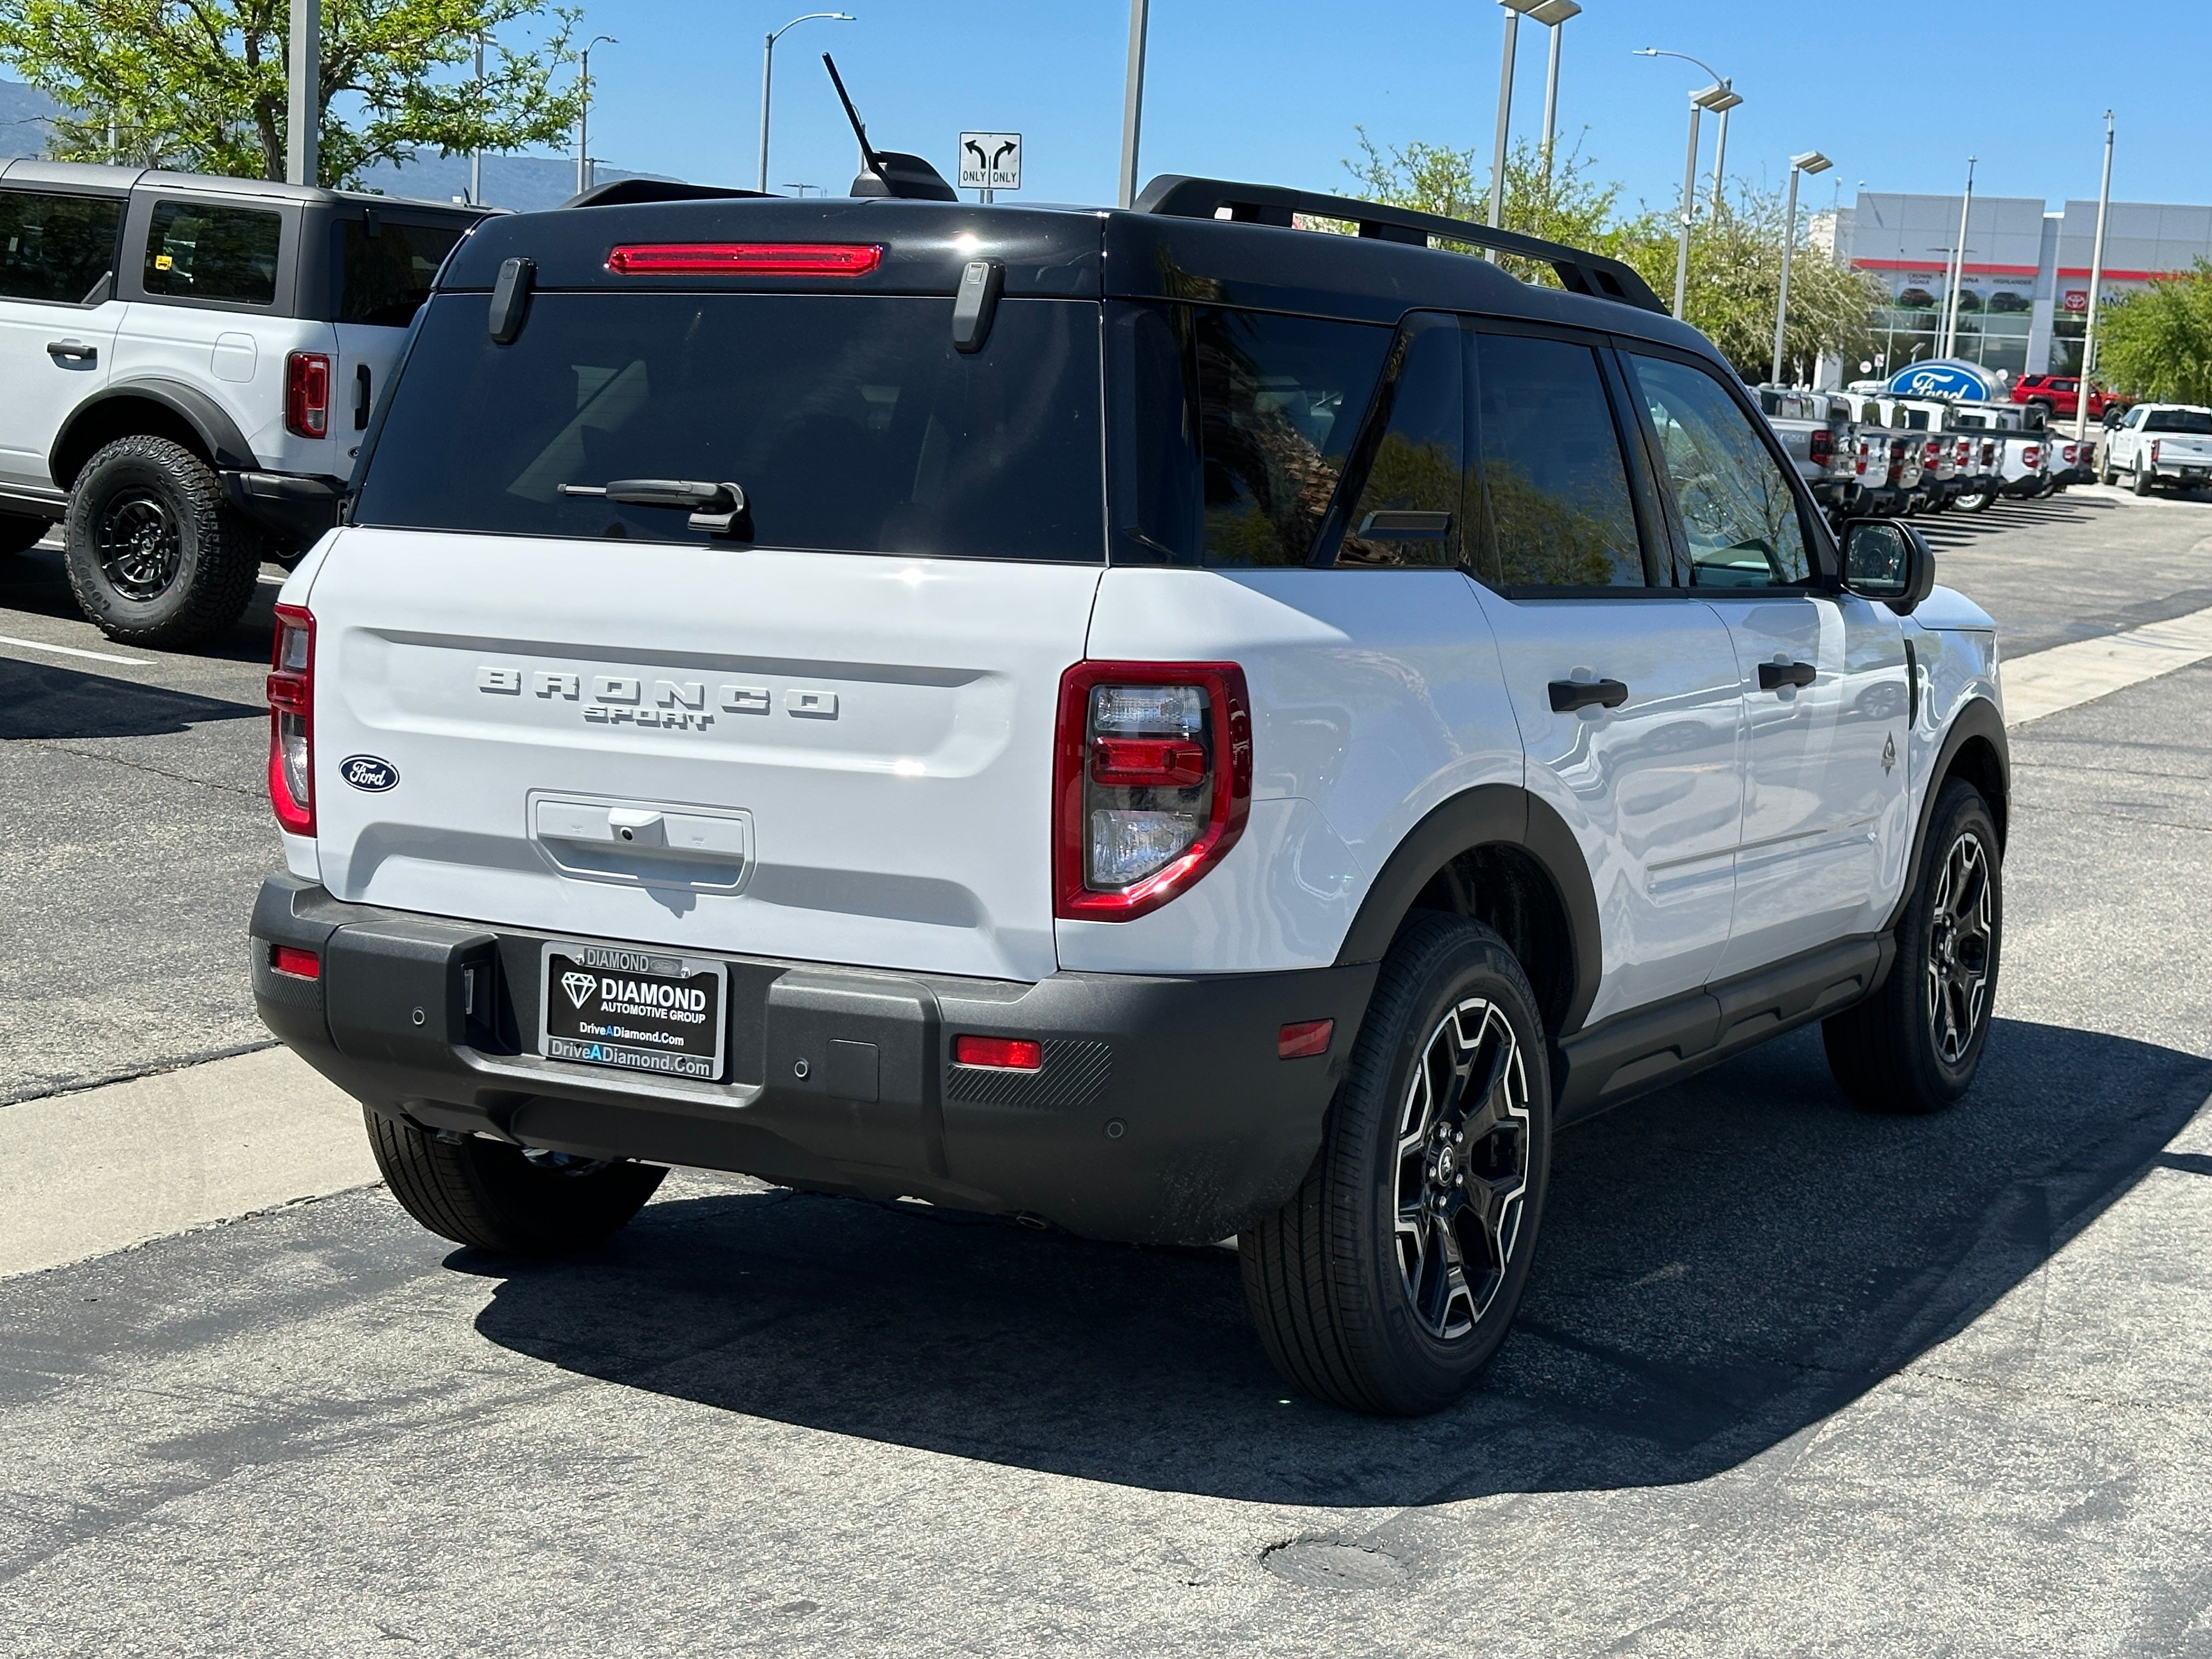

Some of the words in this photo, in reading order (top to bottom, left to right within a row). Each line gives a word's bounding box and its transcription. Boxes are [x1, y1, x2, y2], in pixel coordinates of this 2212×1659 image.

[963, 171, 986, 182] ONLY
[993, 172, 1017, 183] ONLY
[476, 665, 838, 720] BRONCO
[581, 704, 715, 731] SPORT
[349, 760, 387, 786] Ford
[587, 949, 649, 972] DIAMOND
[601, 978, 707, 1012] DIAMOND
[601, 1001, 668, 1019] AUTOMOTIVE
[669, 1009, 707, 1024] GROUP
[579, 1022, 685, 1046] DriveADiamond.Com
[551, 1040, 710, 1076] DriveADiamond.Com
